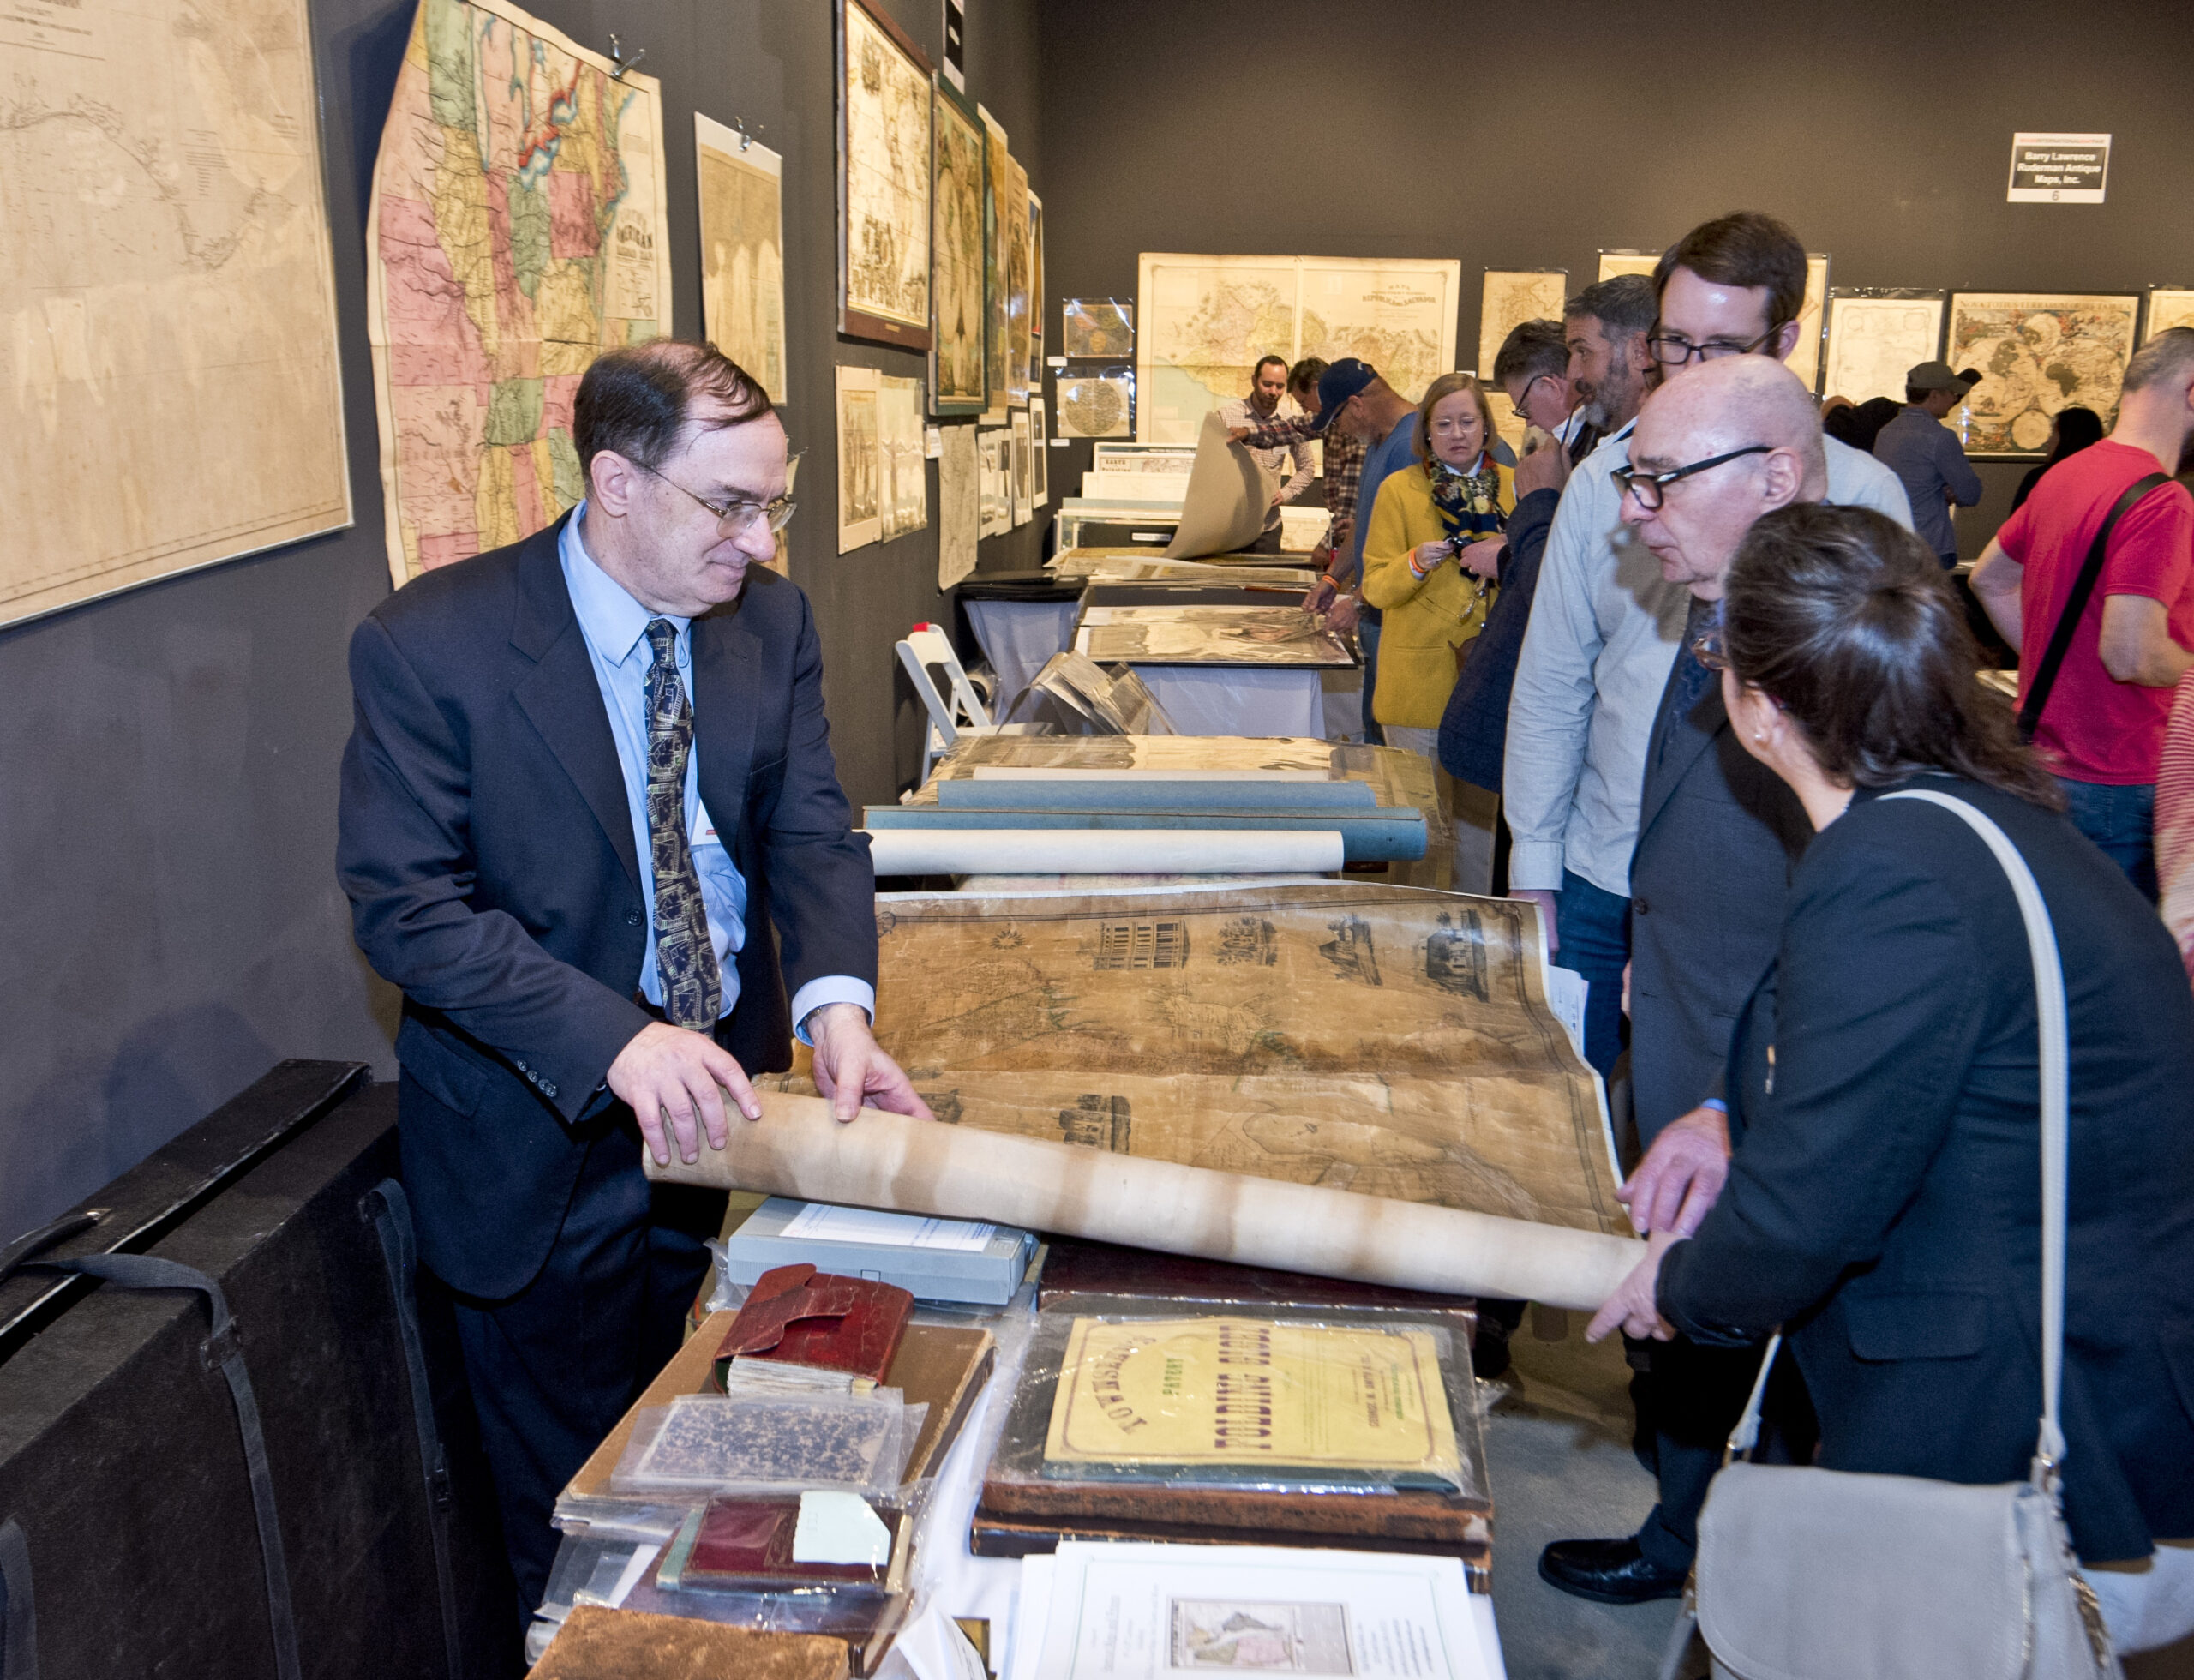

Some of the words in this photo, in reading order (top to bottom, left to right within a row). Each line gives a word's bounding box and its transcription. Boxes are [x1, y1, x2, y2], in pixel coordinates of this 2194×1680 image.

[2024, 151, 2050, 162] Barry
[2051, 152, 2096, 161] Lawrence
[2017, 163, 2065, 172] Ruderman
[2065, 164, 2102, 174] Antique
[2034, 175, 2062, 185] Maps,
[2063, 175, 2081, 184] Inc.
[2052, 190, 2060, 201] 6
[1217, 1325, 1271, 1365] GLOBE
[1162, 1357, 1184, 1396] PATENT
[1214, 1372, 1272, 1449] FOLDING
